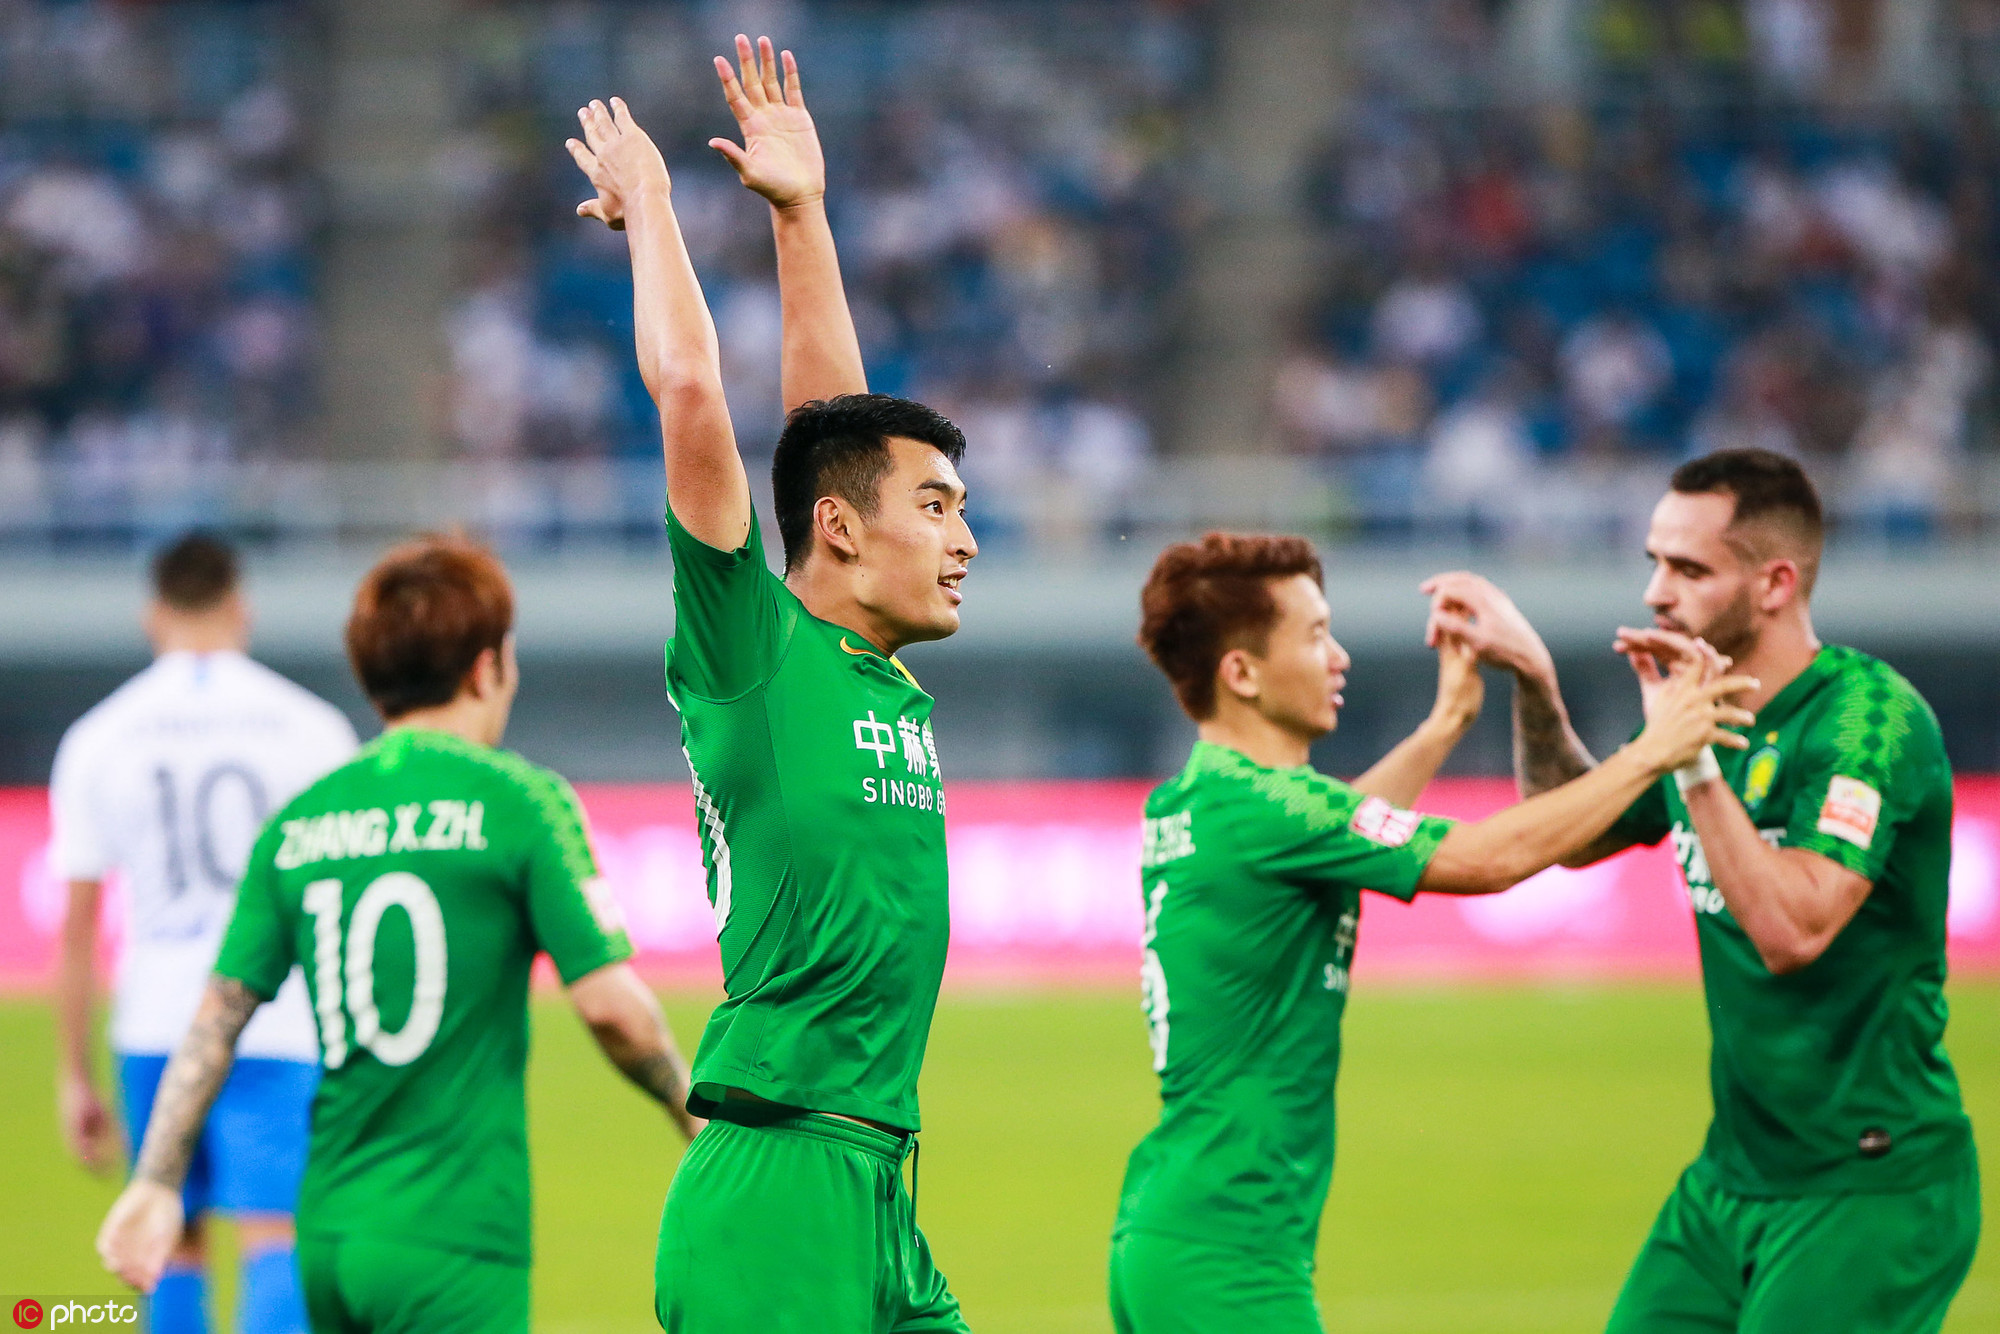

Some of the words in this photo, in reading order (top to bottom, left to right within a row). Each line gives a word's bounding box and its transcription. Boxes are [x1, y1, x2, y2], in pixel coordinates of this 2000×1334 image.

[154, 762, 270, 895] 10
[274, 808, 389, 870] ZHANG
[862, 777, 933, 811] SINOBO
[302, 871, 448, 1070] 10
